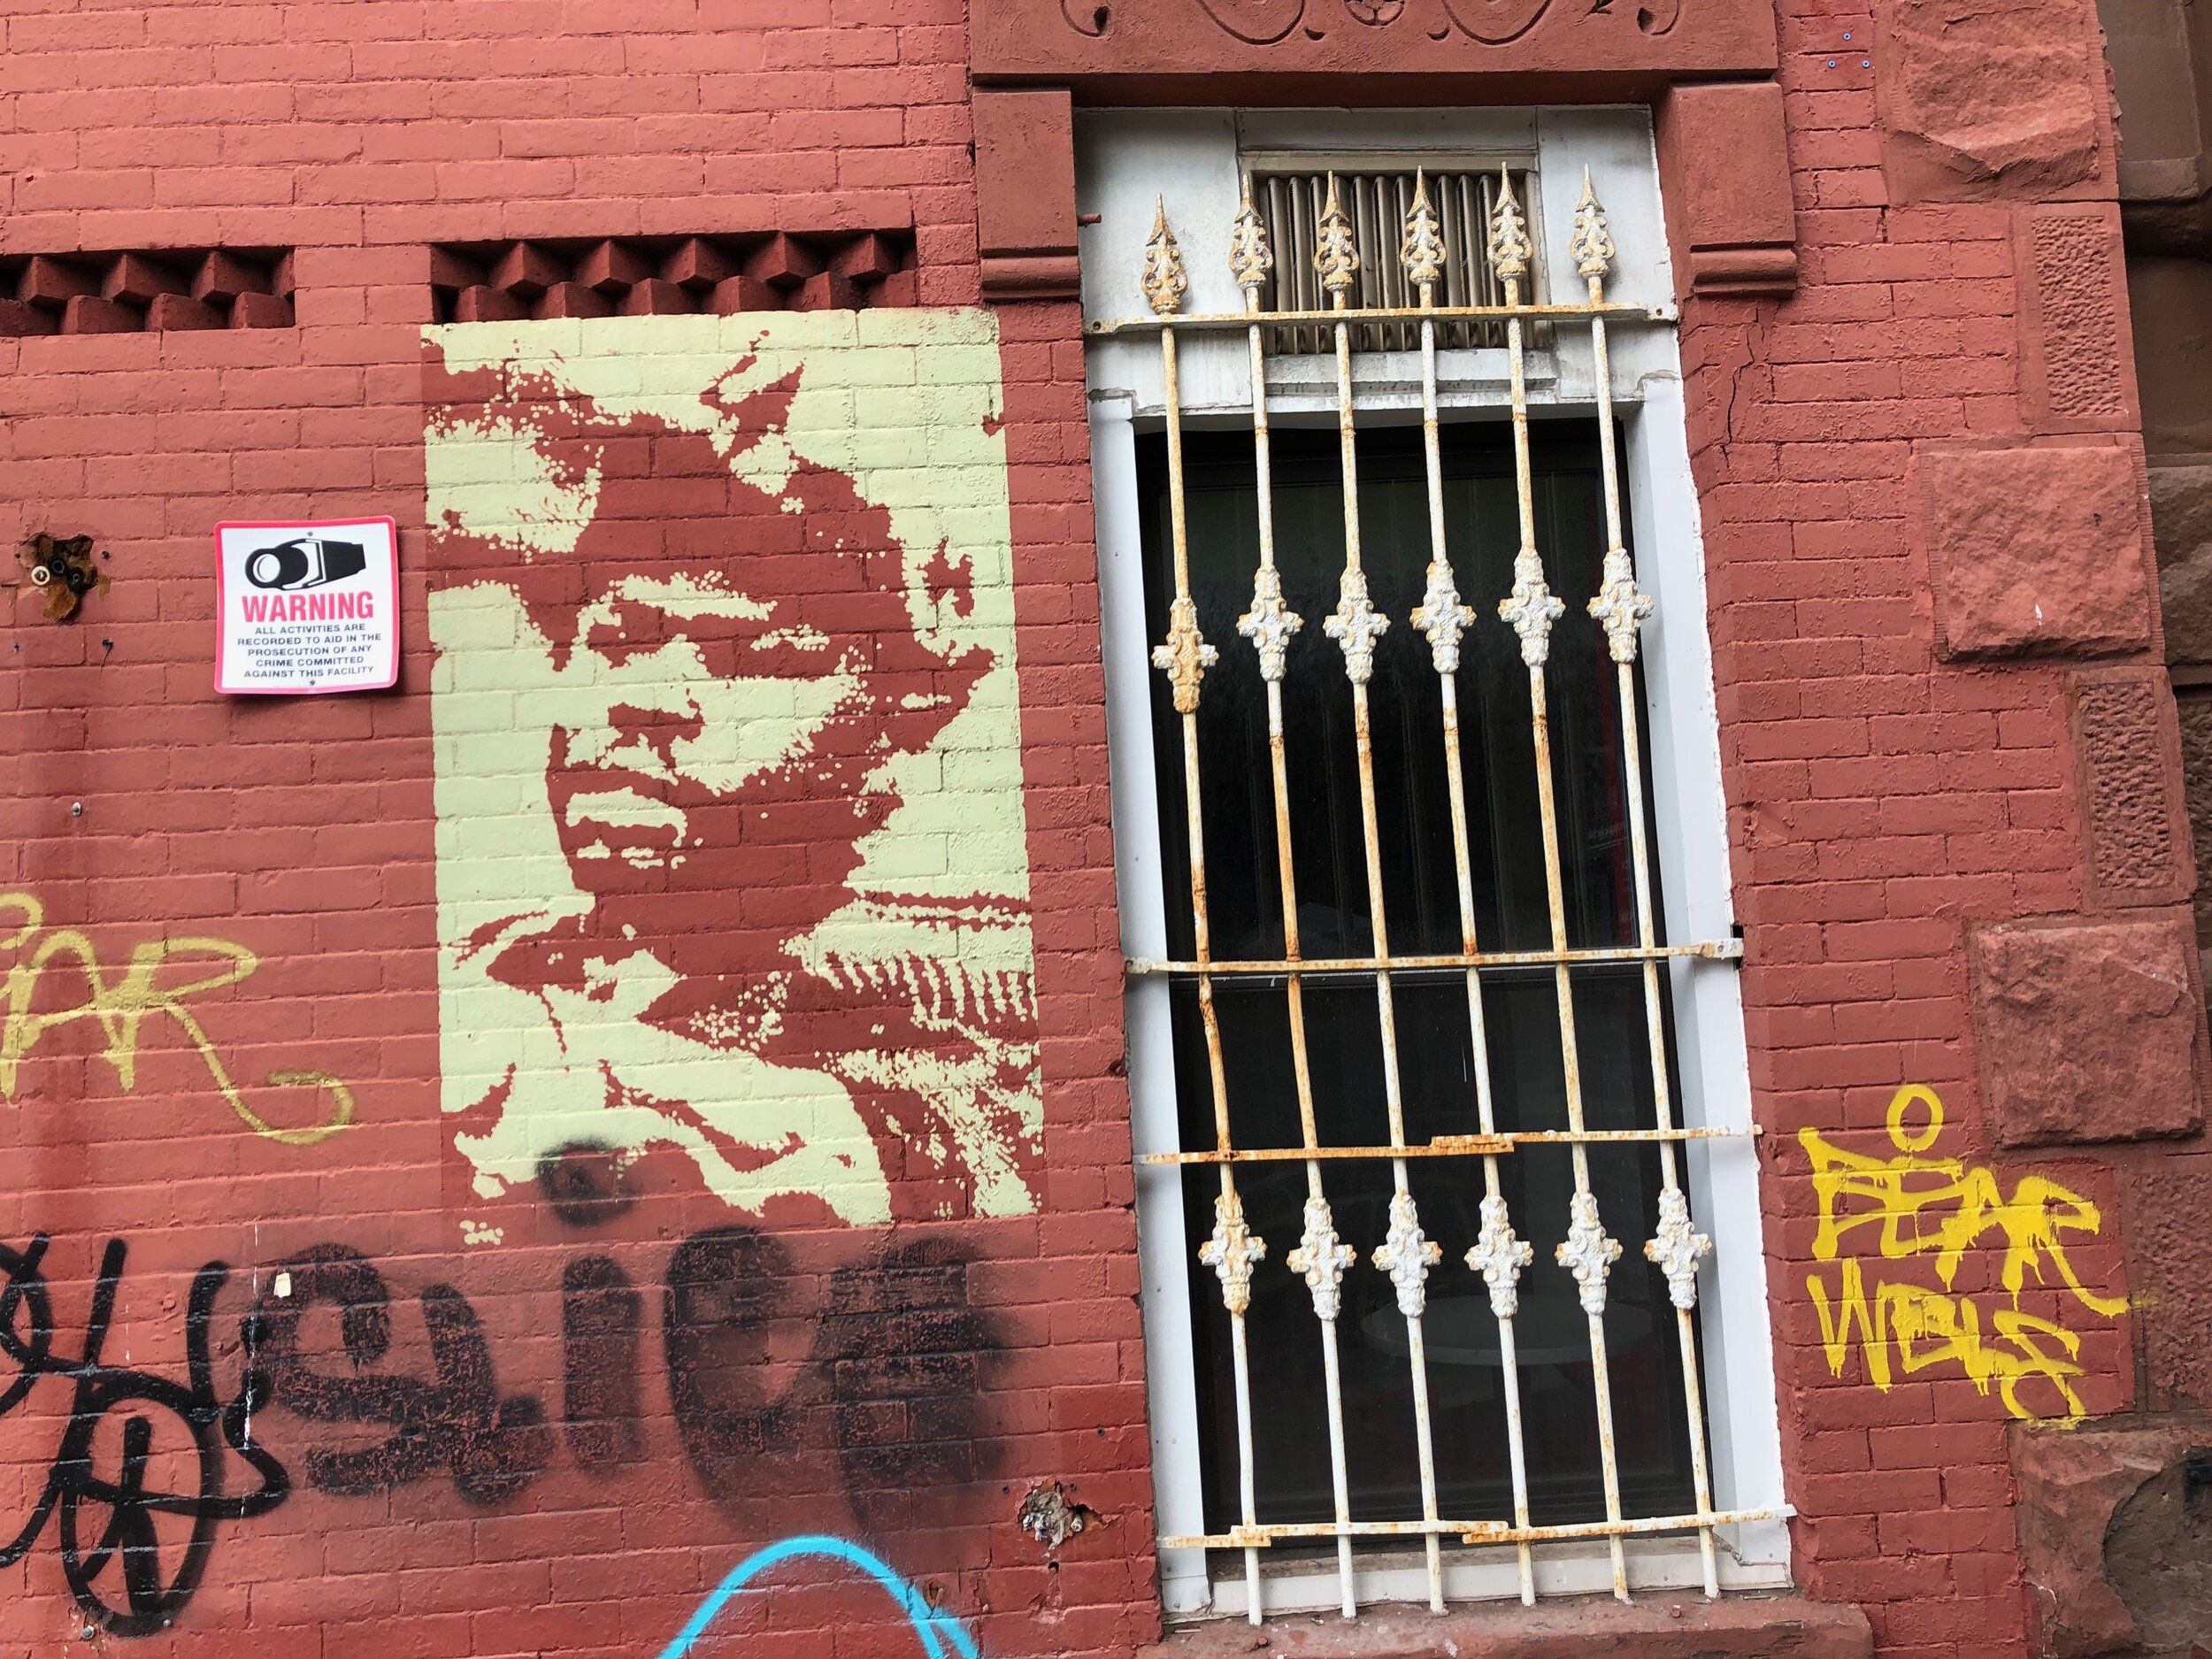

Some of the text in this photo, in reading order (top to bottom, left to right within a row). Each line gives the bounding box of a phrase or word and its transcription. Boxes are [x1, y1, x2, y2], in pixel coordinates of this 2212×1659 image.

[242, 591, 373, 623] WARNING
[280, 624, 340, 634] ACTIVITIES
[238, 637, 301, 646] RECORDED
[362, 633, 381, 641] THE
[248, 647, 329, 657] PROSECUTION
[350, 644, 372, 653] ANY
[256, 656, 365, 667] CRIME COMMITTED
[299, 669, 324, 678] THIS
[327, 666, 373, 676] FACILITY
